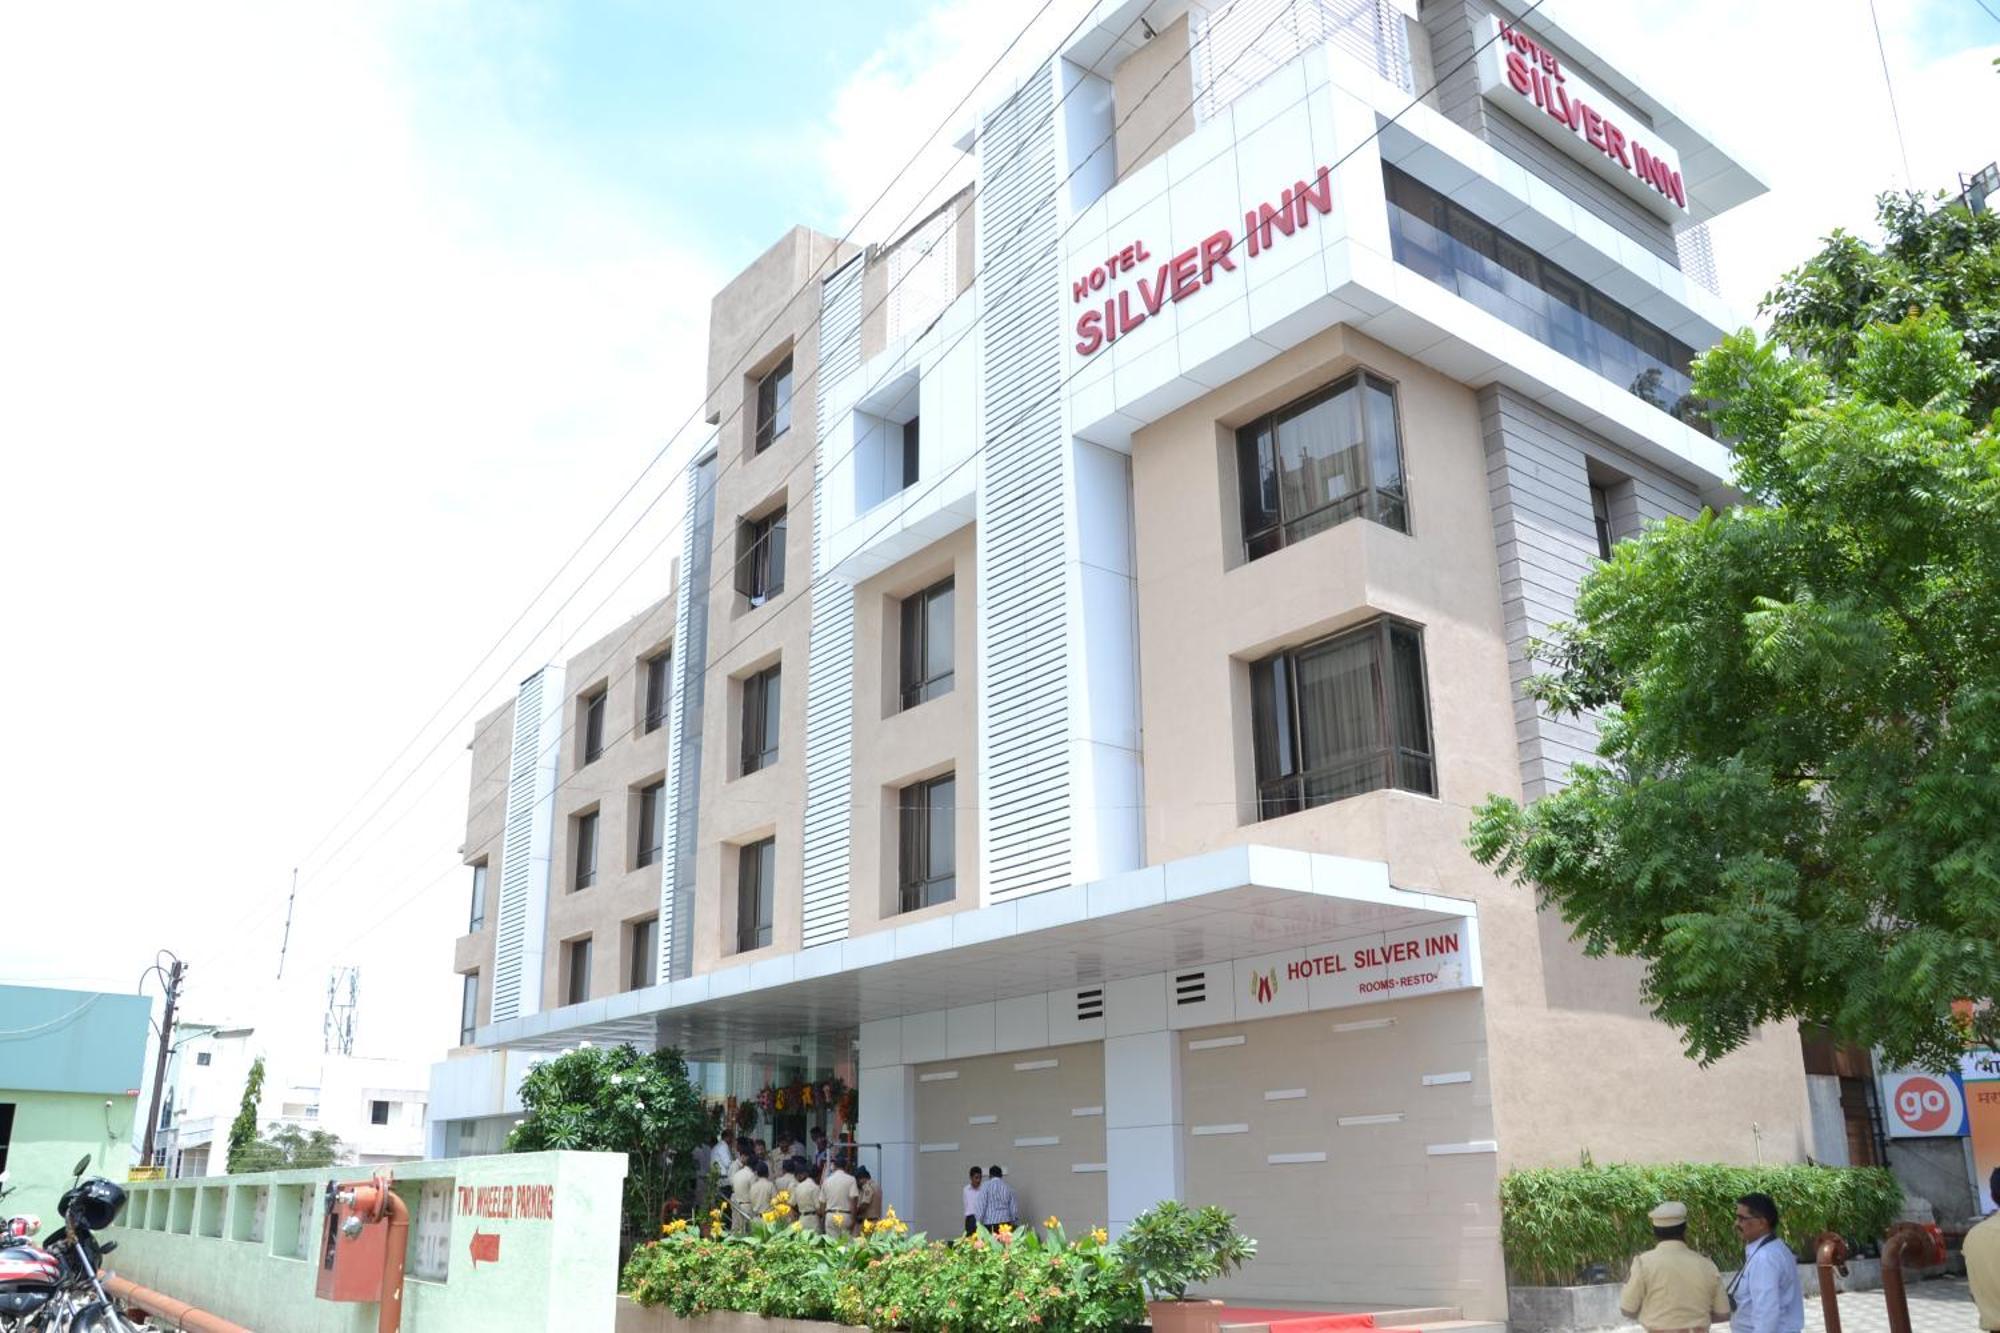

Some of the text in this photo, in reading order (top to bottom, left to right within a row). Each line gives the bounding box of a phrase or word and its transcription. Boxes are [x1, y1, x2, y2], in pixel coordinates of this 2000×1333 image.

[1499, 19, 1565, 83] HOTEL
[1506, 52, 1685, 208] SILVER INN
[1073, 240, 1150, 303] HOTEL
[1076, 165, 1332, 356] SILVER INN
[1287, 933, 1459, 981] HOTEL SILVER INN
[1900, 1090, 1945, 1121] go
[458, 1184, 554, 1220] TWO WHEELER PARKING
